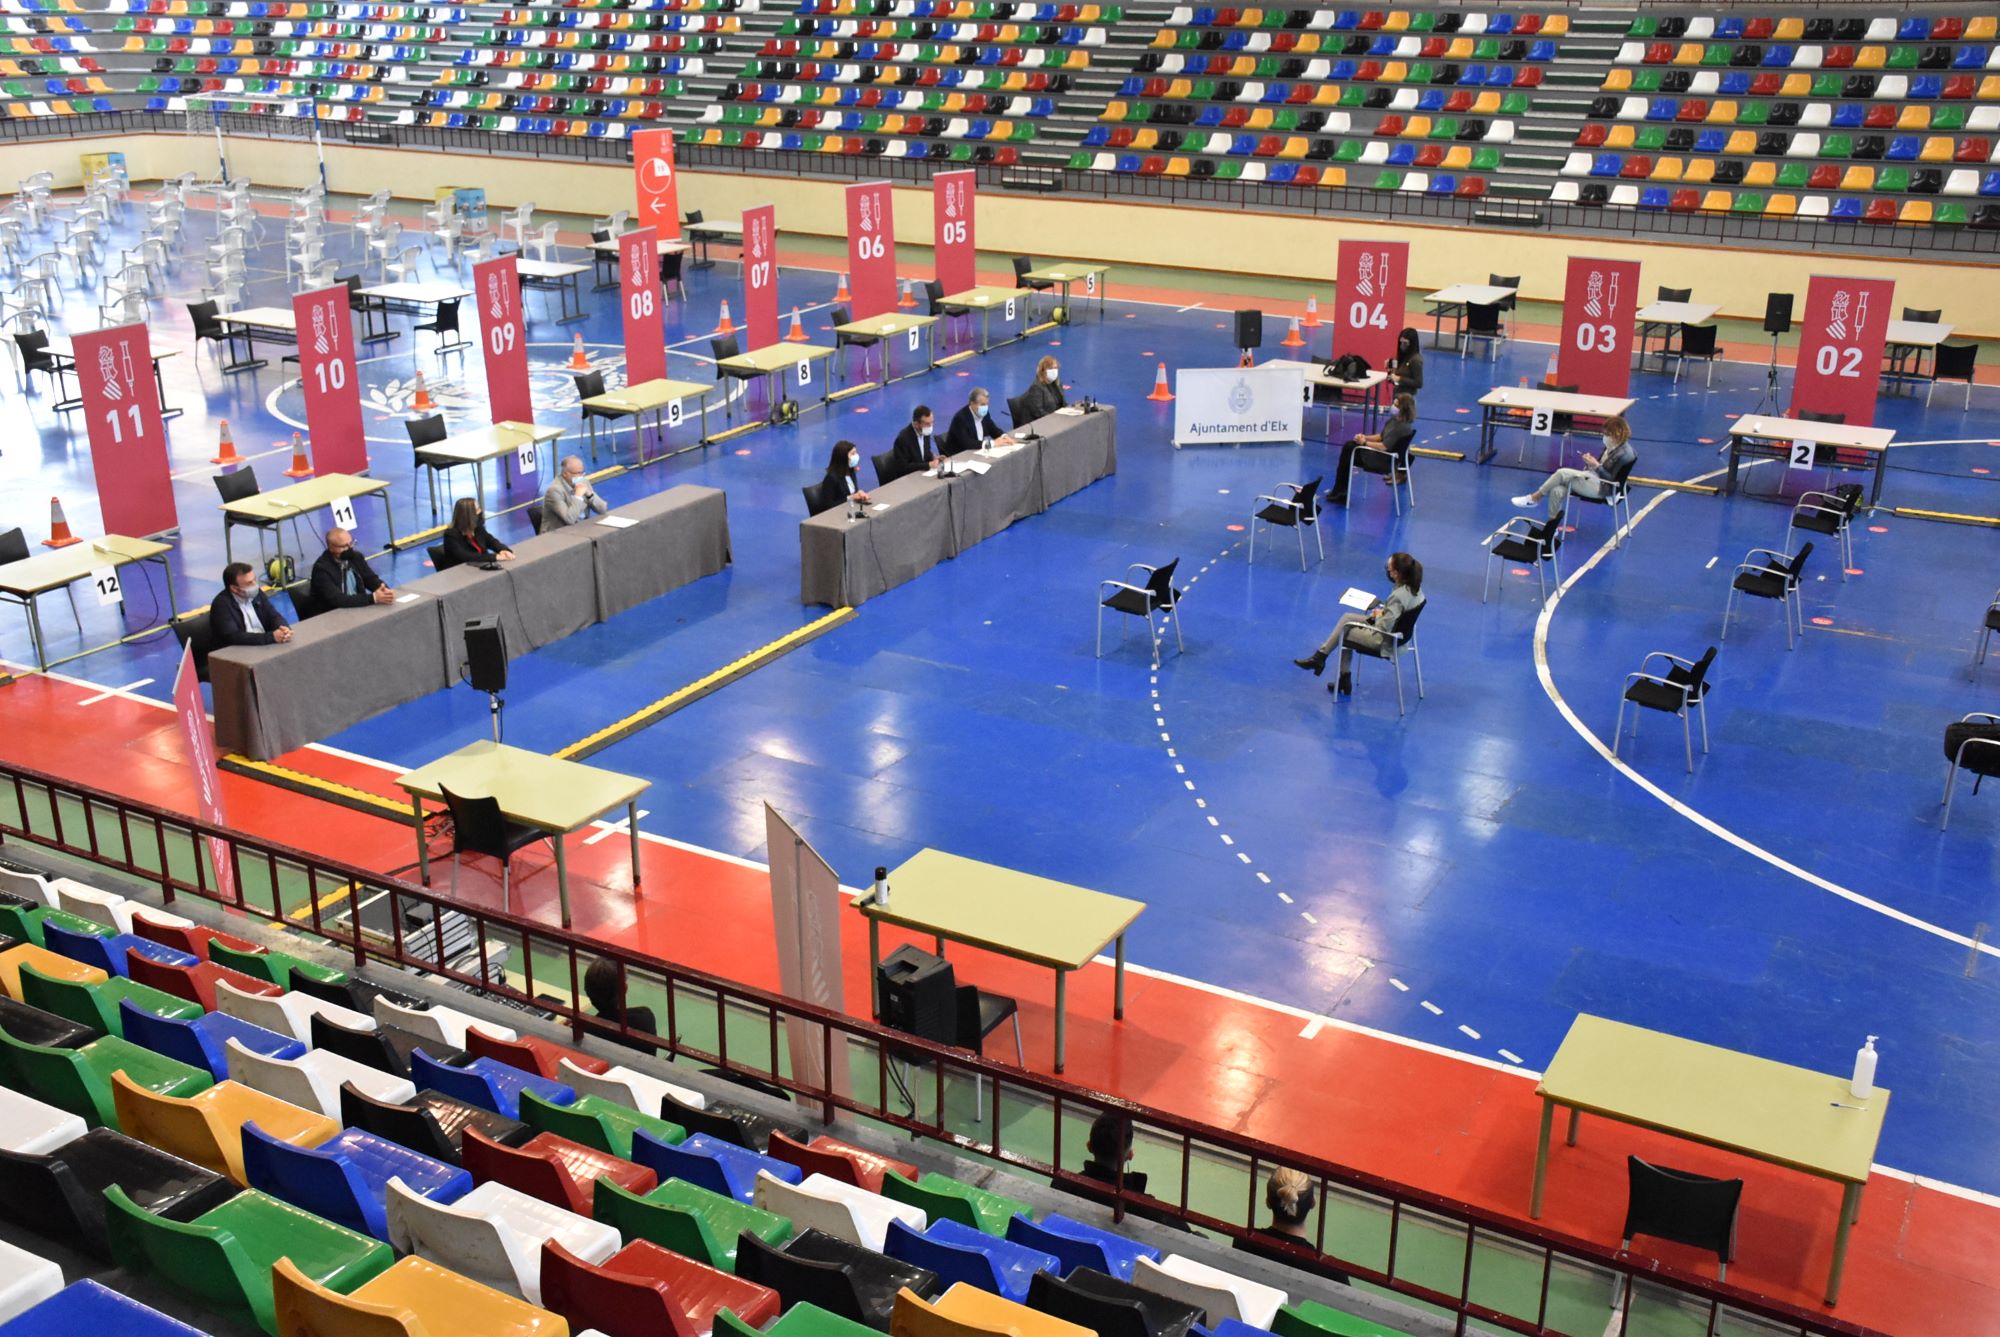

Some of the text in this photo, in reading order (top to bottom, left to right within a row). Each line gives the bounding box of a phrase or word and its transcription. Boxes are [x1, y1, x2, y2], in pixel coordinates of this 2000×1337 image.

[943, 221, 967, 245] 05
[858, 235, 885, 261] 06
[751, 261, 770, 289] 07
[1087, 277, 1094, 290] 5
[630, 289, 654, 320] 08
[1007, 302, 1014, 317] 6
[1349, 301, 1388, 330] 04
[491, 322, 515, 355] 09
[910, 330, 917, 346] 7
[1576, 322, 1617, 353] 03
[1816, 345, 1863, 378] 02
[315, 358, 345, 394] 10
[800, 364, 809, 381] 8
[106, 404, 144, 443] 11
[670, 404, 680, 422] 9
[1534, 413, 1549, 431] 3
[1190, 420, 1288, 436] Ajuntament d'Elx
[520, 449, 534, 466] 10
[1794, 444, 1810, 465] 2
[334, 505, 354, 523] 11
[96, 575, 119, 595] 12
